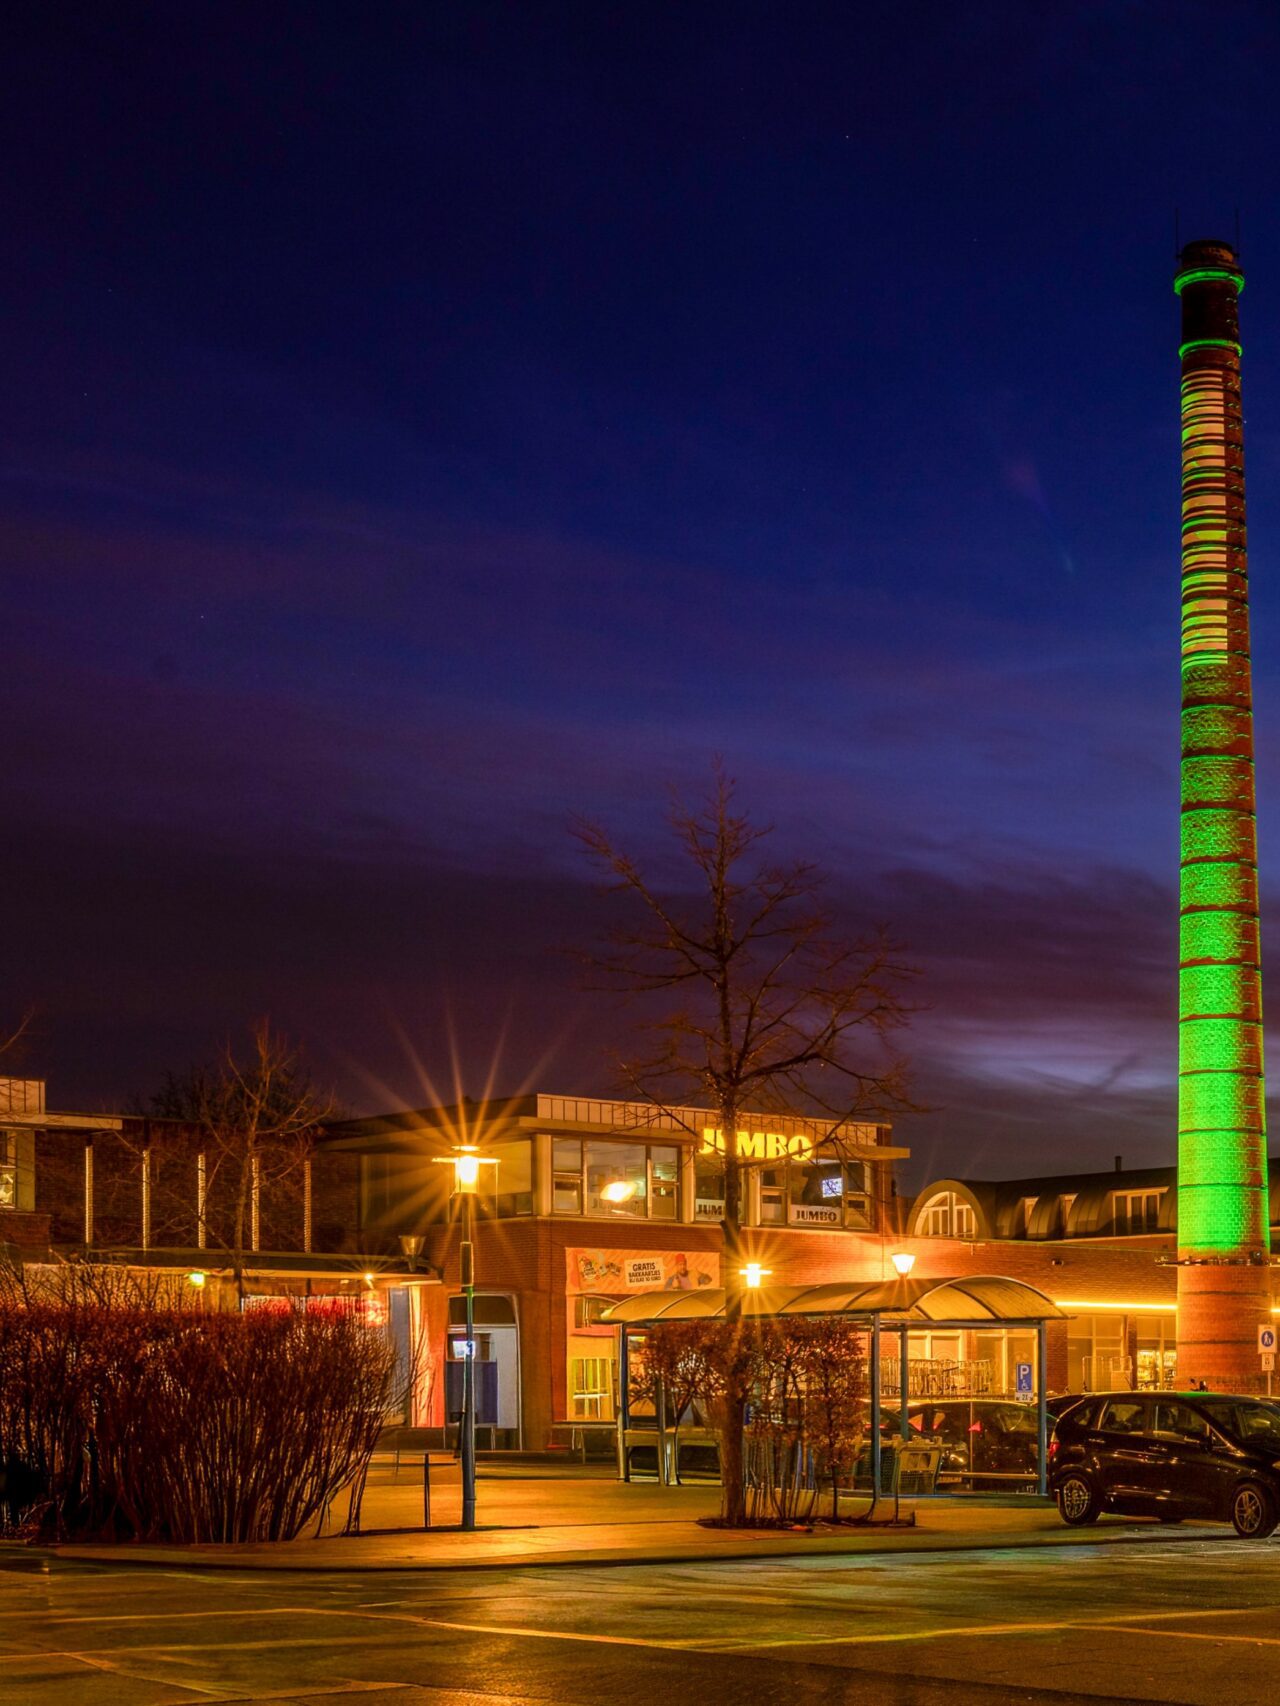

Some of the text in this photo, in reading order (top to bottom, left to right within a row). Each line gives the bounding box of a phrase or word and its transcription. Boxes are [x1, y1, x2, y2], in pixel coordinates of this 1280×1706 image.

[795, 1209, 837, 1221] JUMBO
[632, 1262, 656, 1271] GRATIS
[1020, 1365, 1030, 1380] P
